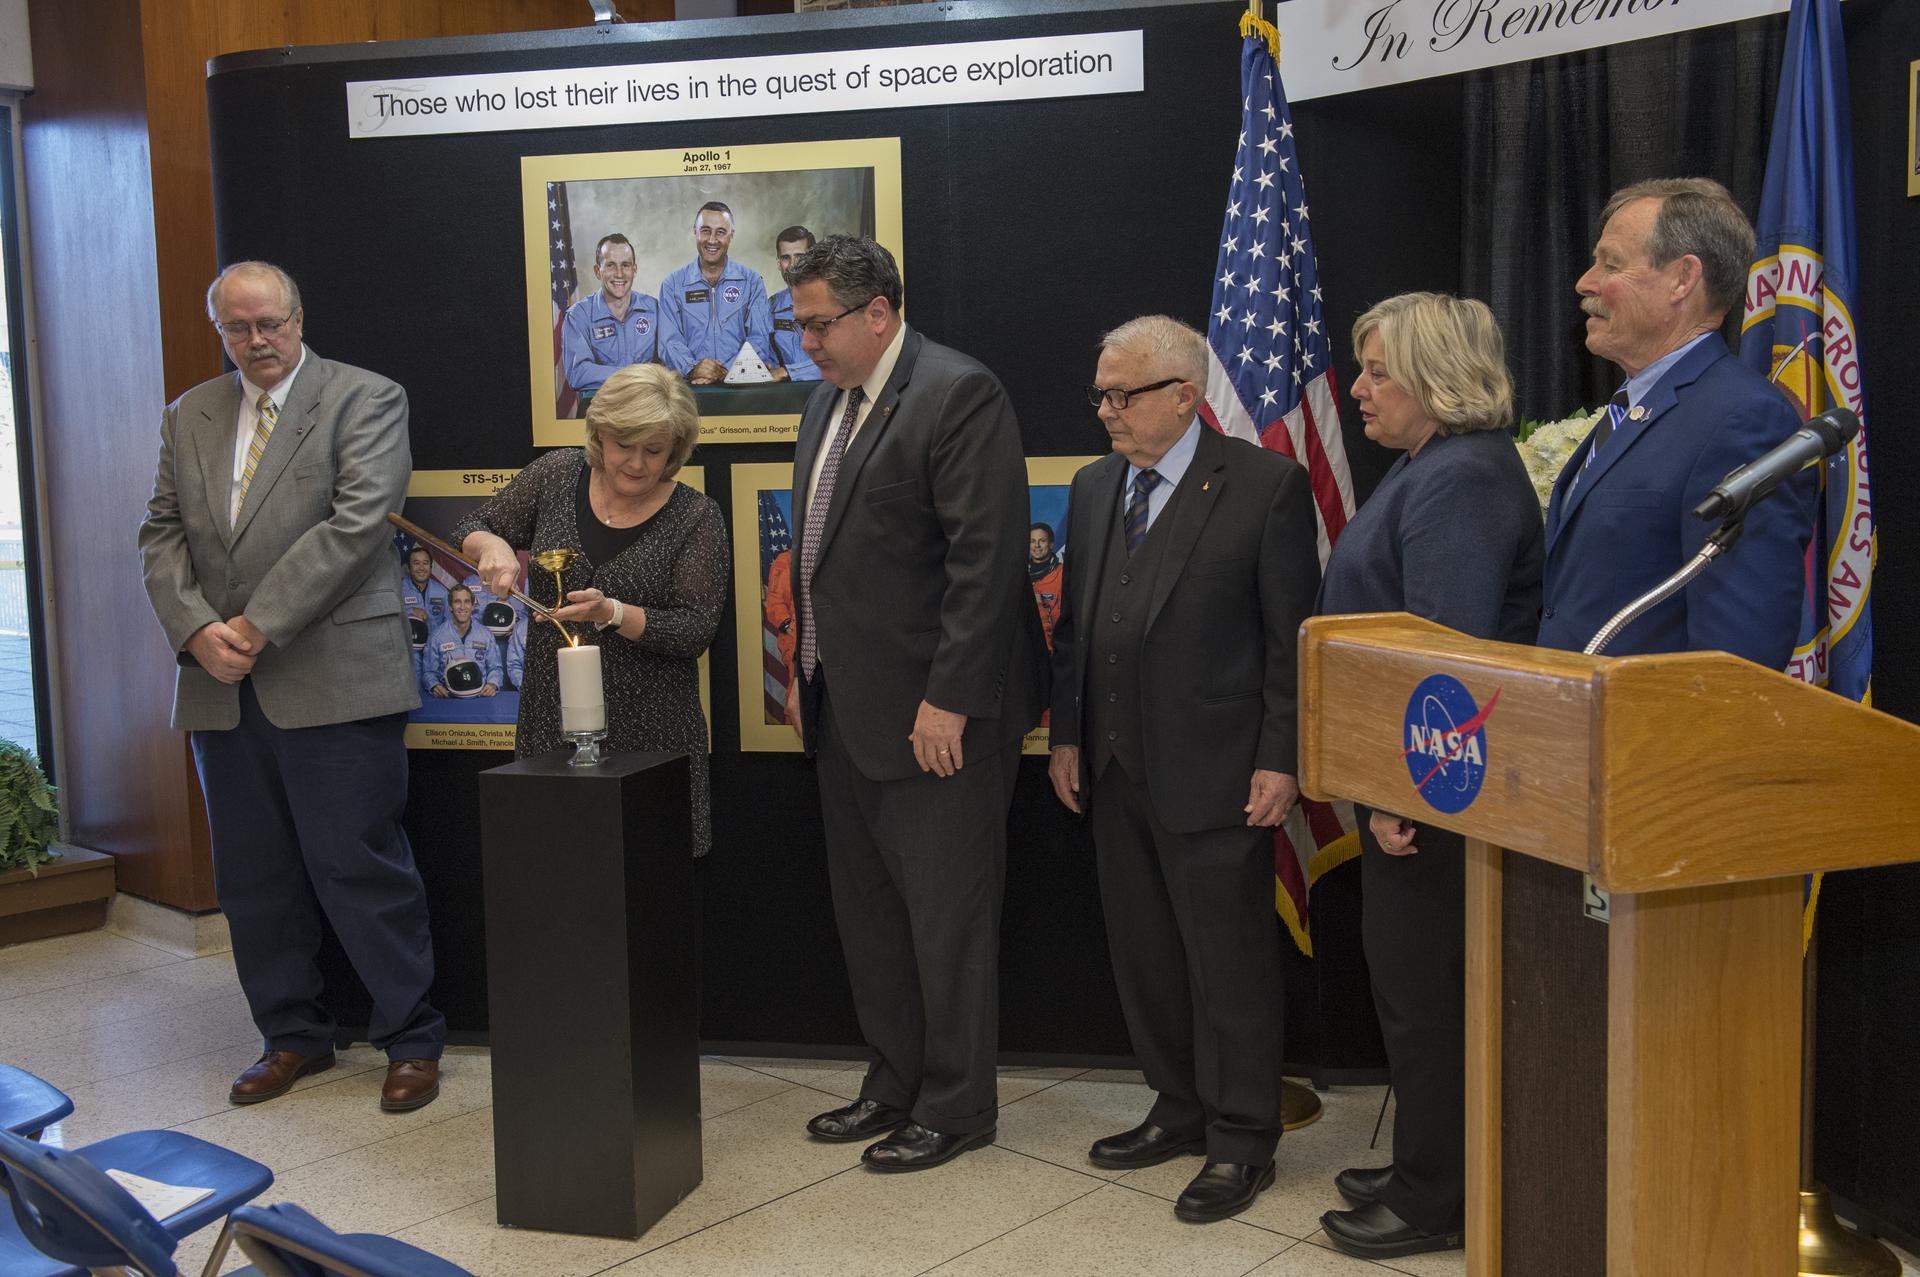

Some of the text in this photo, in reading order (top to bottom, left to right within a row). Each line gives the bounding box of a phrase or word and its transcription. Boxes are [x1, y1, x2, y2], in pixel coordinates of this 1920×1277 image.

[1331, 0, 1414, 71] In
[373, 49, 1113, 118] Those who lost their lives in the quest of space exploration
[683, 150, 730, 164] Apollo 1
[700, 164, 711, 172] 27,
[713, 163, 731, 171] 1967
[719, 426, 751, 434] Grissom,
[753, 425, 767, 433] and
[769, 425, 791, 434] Roger
[449, 729, 478, 738] Onizuka,
[479, 729, 503, 738] Christa
[431, 738, 457, 746] Michael
[490, 739, 513, 747] Francis
[1410, 723, 1483, 766] NASA
